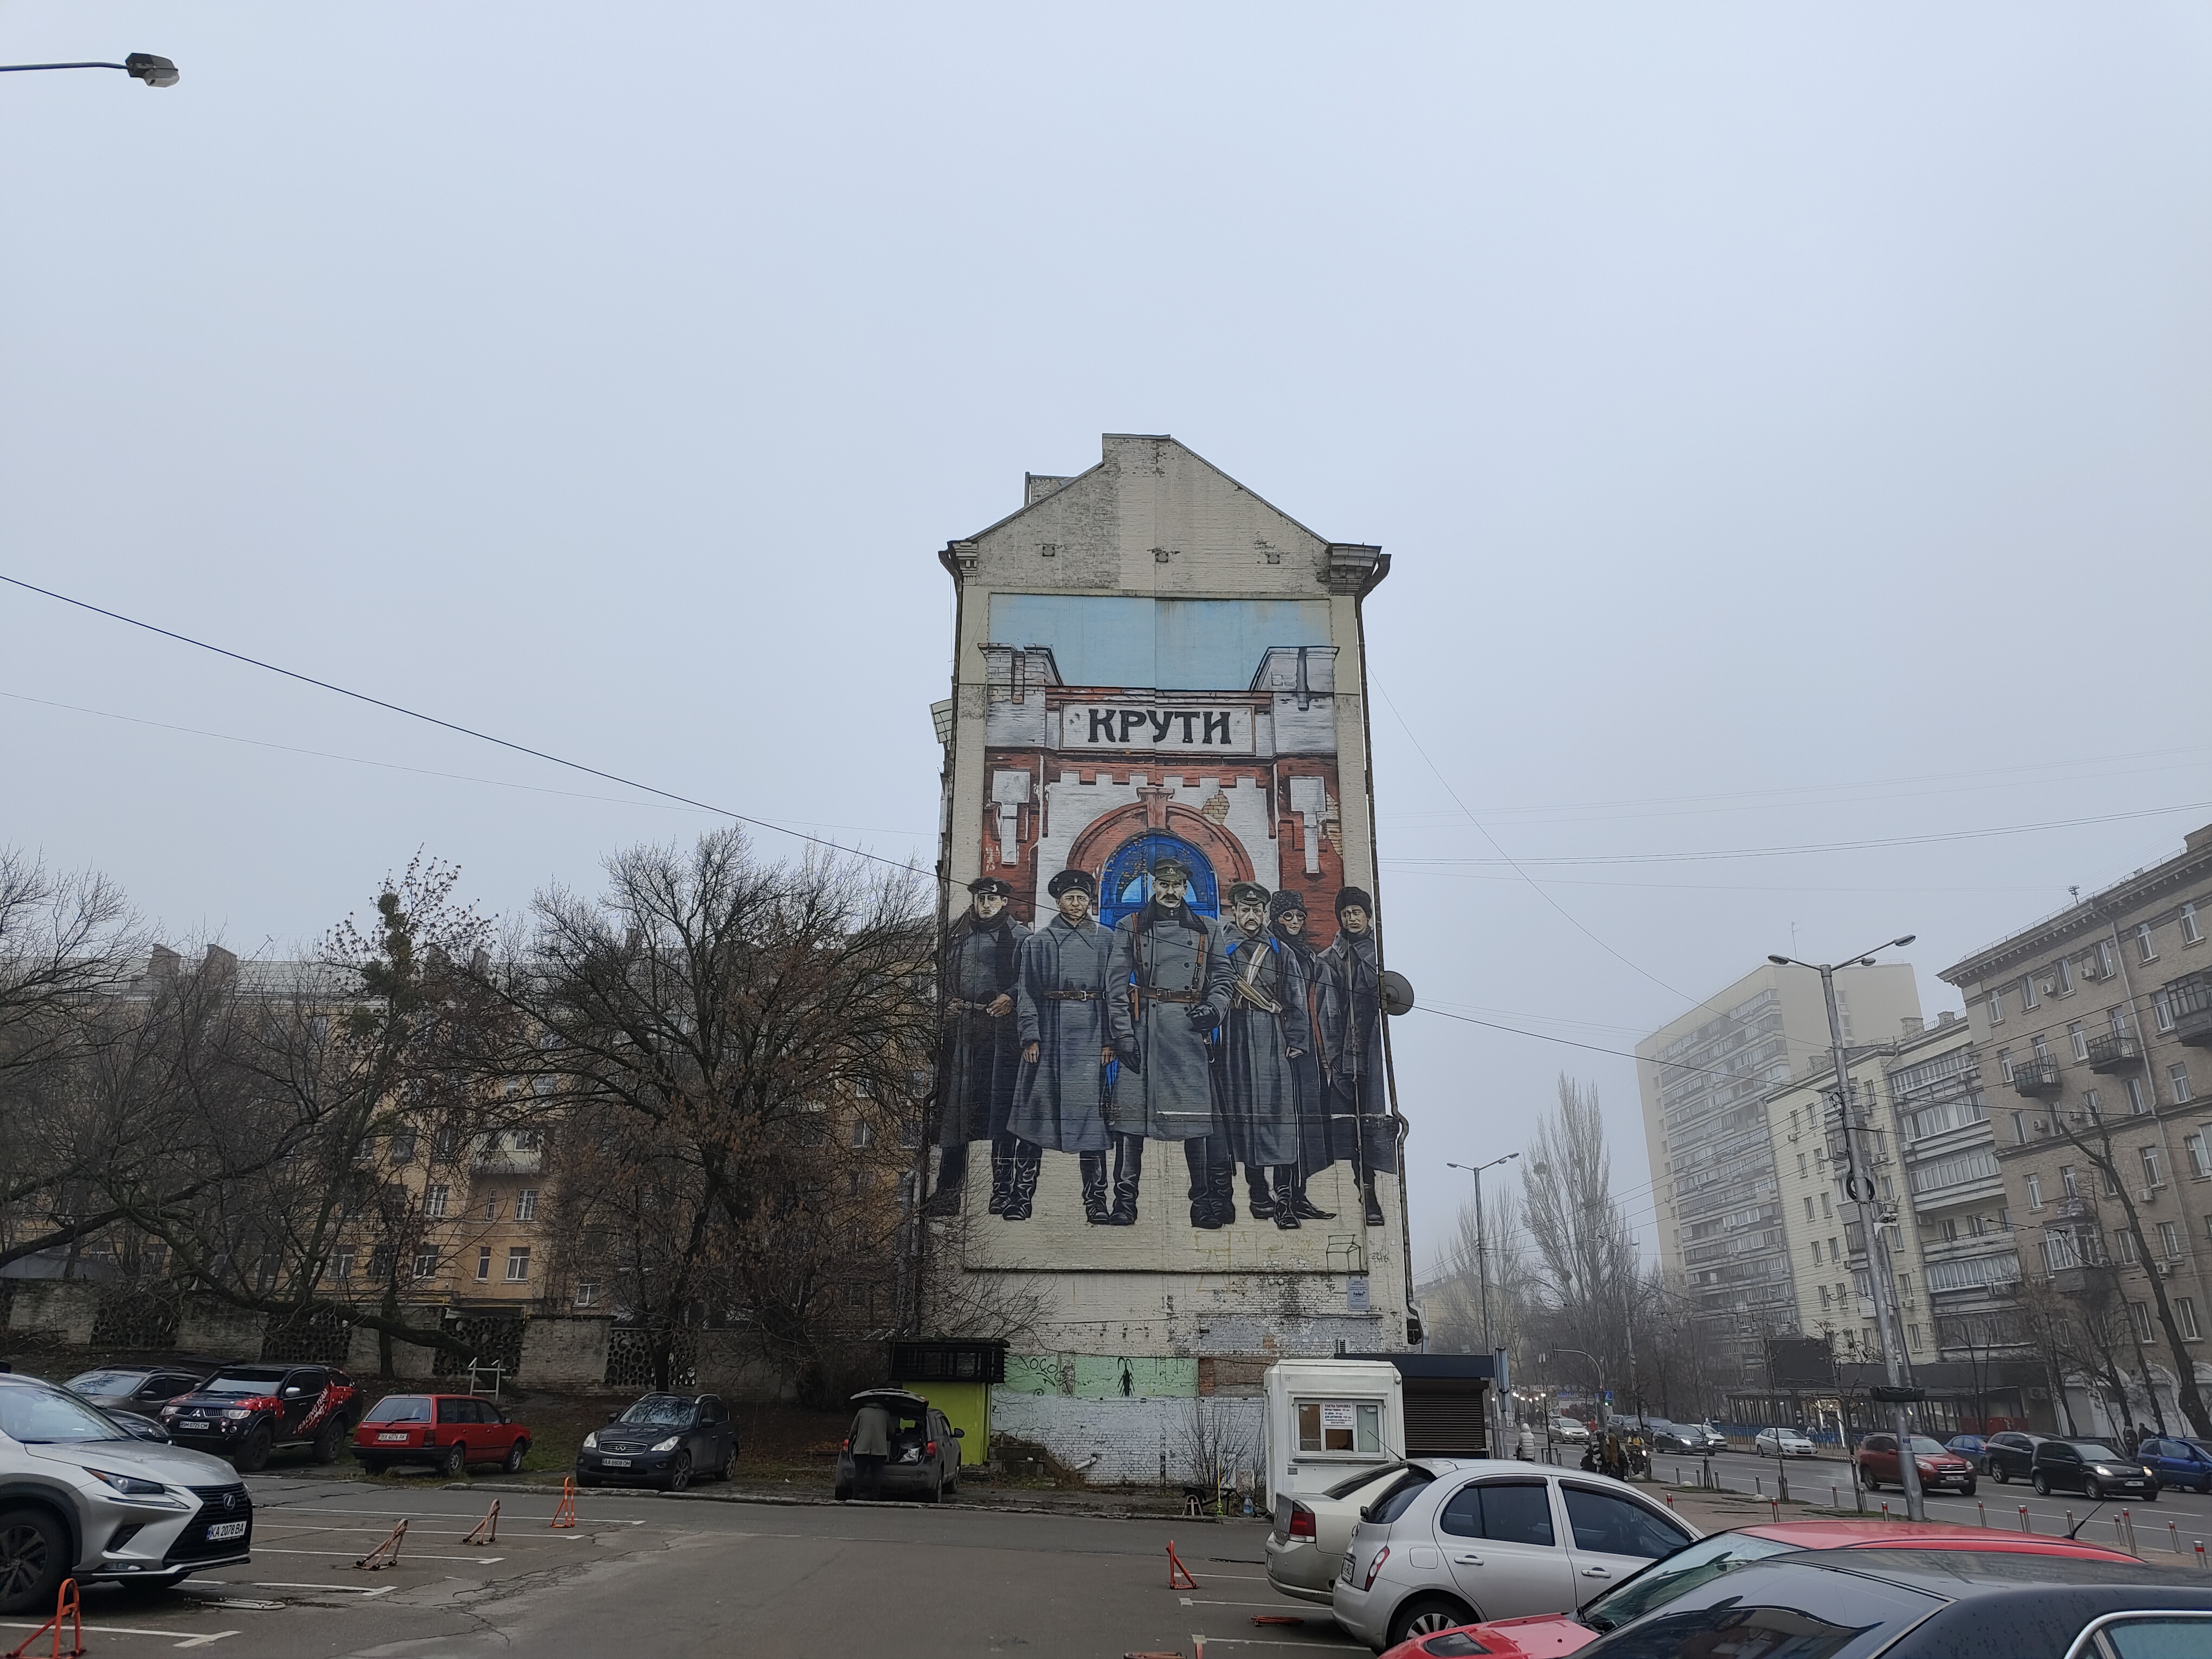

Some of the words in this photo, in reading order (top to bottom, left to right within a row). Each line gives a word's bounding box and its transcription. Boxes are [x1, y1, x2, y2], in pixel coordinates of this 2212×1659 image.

[1088, 708, 1232, 744] КРУТИ
[298, 1404, 318, 1432] RACING
[316, 1388, 329, 1407] TEAM
[210, 1526, 220, 1538] KA
[220, 1524, 235, 1536] 2078
[235, 1523, 244, 1534] BA
